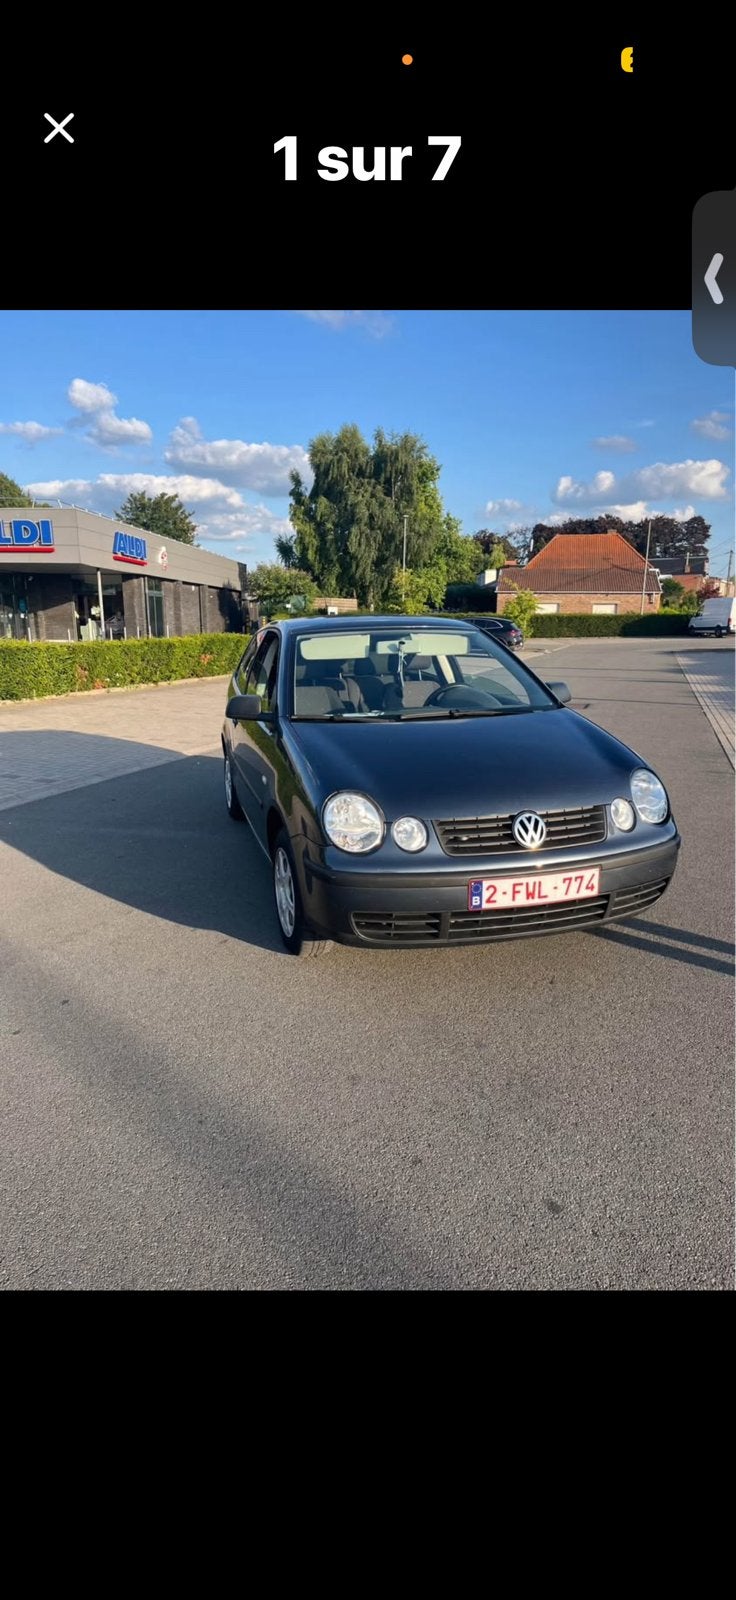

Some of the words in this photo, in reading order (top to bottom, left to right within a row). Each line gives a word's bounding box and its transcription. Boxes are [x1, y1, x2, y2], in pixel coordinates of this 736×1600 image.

[112, 531, 147, 560] ALDI
[472, 896, 480, 905] B
[485, 873, 595, 904] 2-FWL-774
